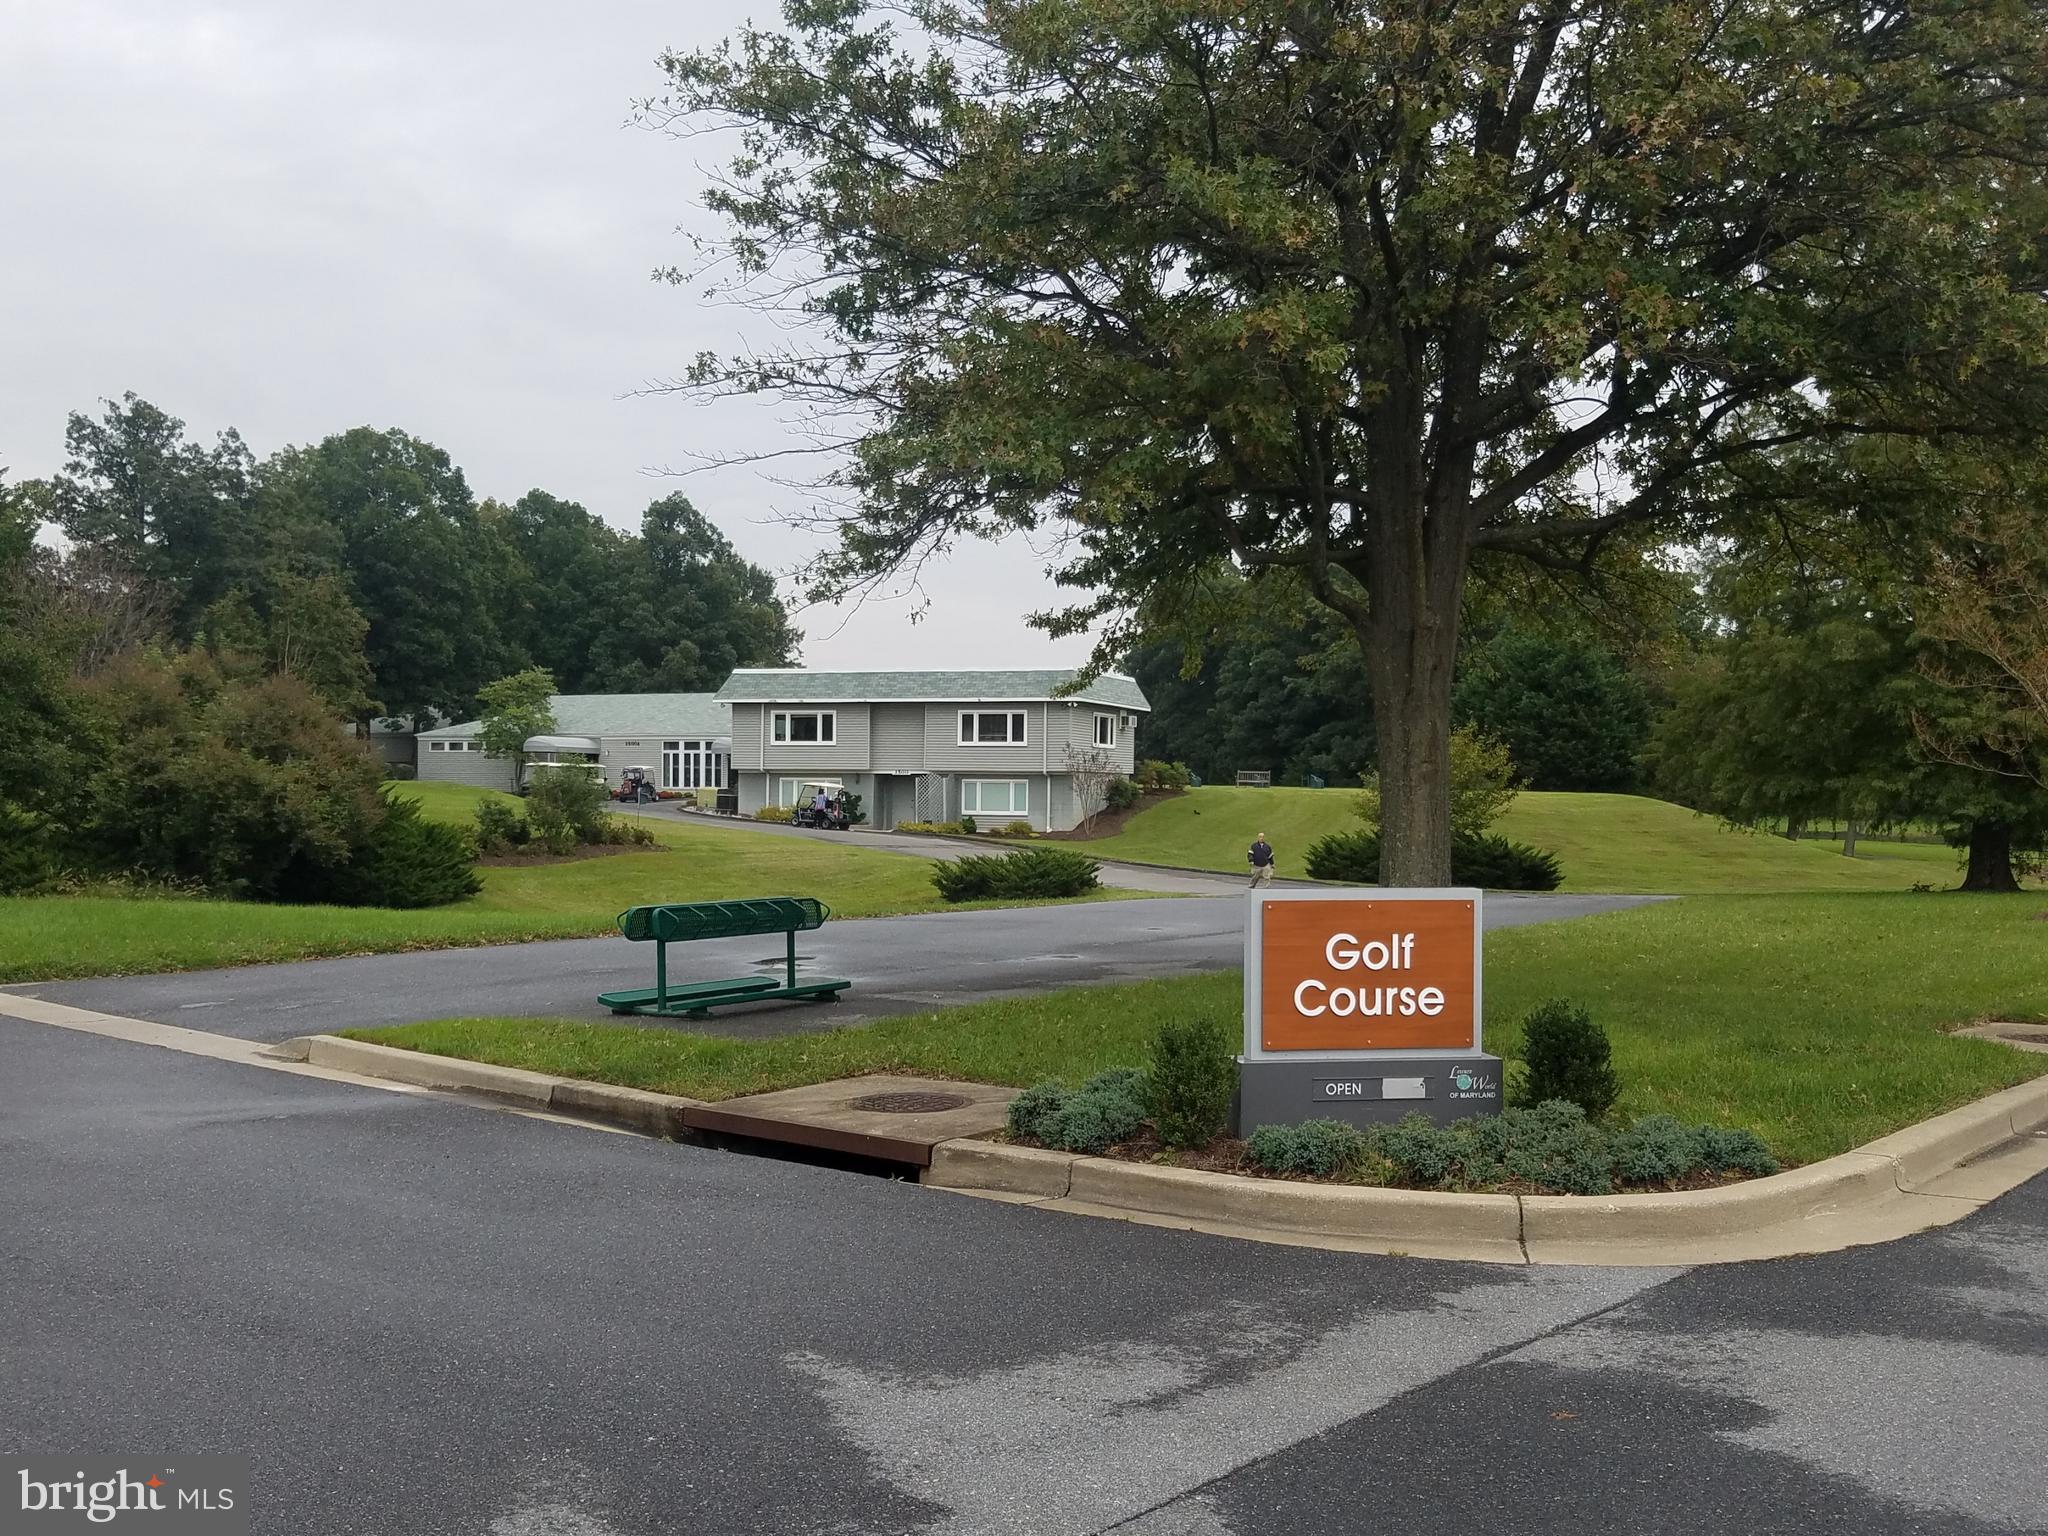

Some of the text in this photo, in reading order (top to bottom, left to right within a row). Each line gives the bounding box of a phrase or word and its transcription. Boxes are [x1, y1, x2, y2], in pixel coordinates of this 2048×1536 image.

[1325, 933, 1415, 971] Golf
[1293, 979, 1445, 1017] Course
[1325, 1082, 1362, 1096] OPEN
